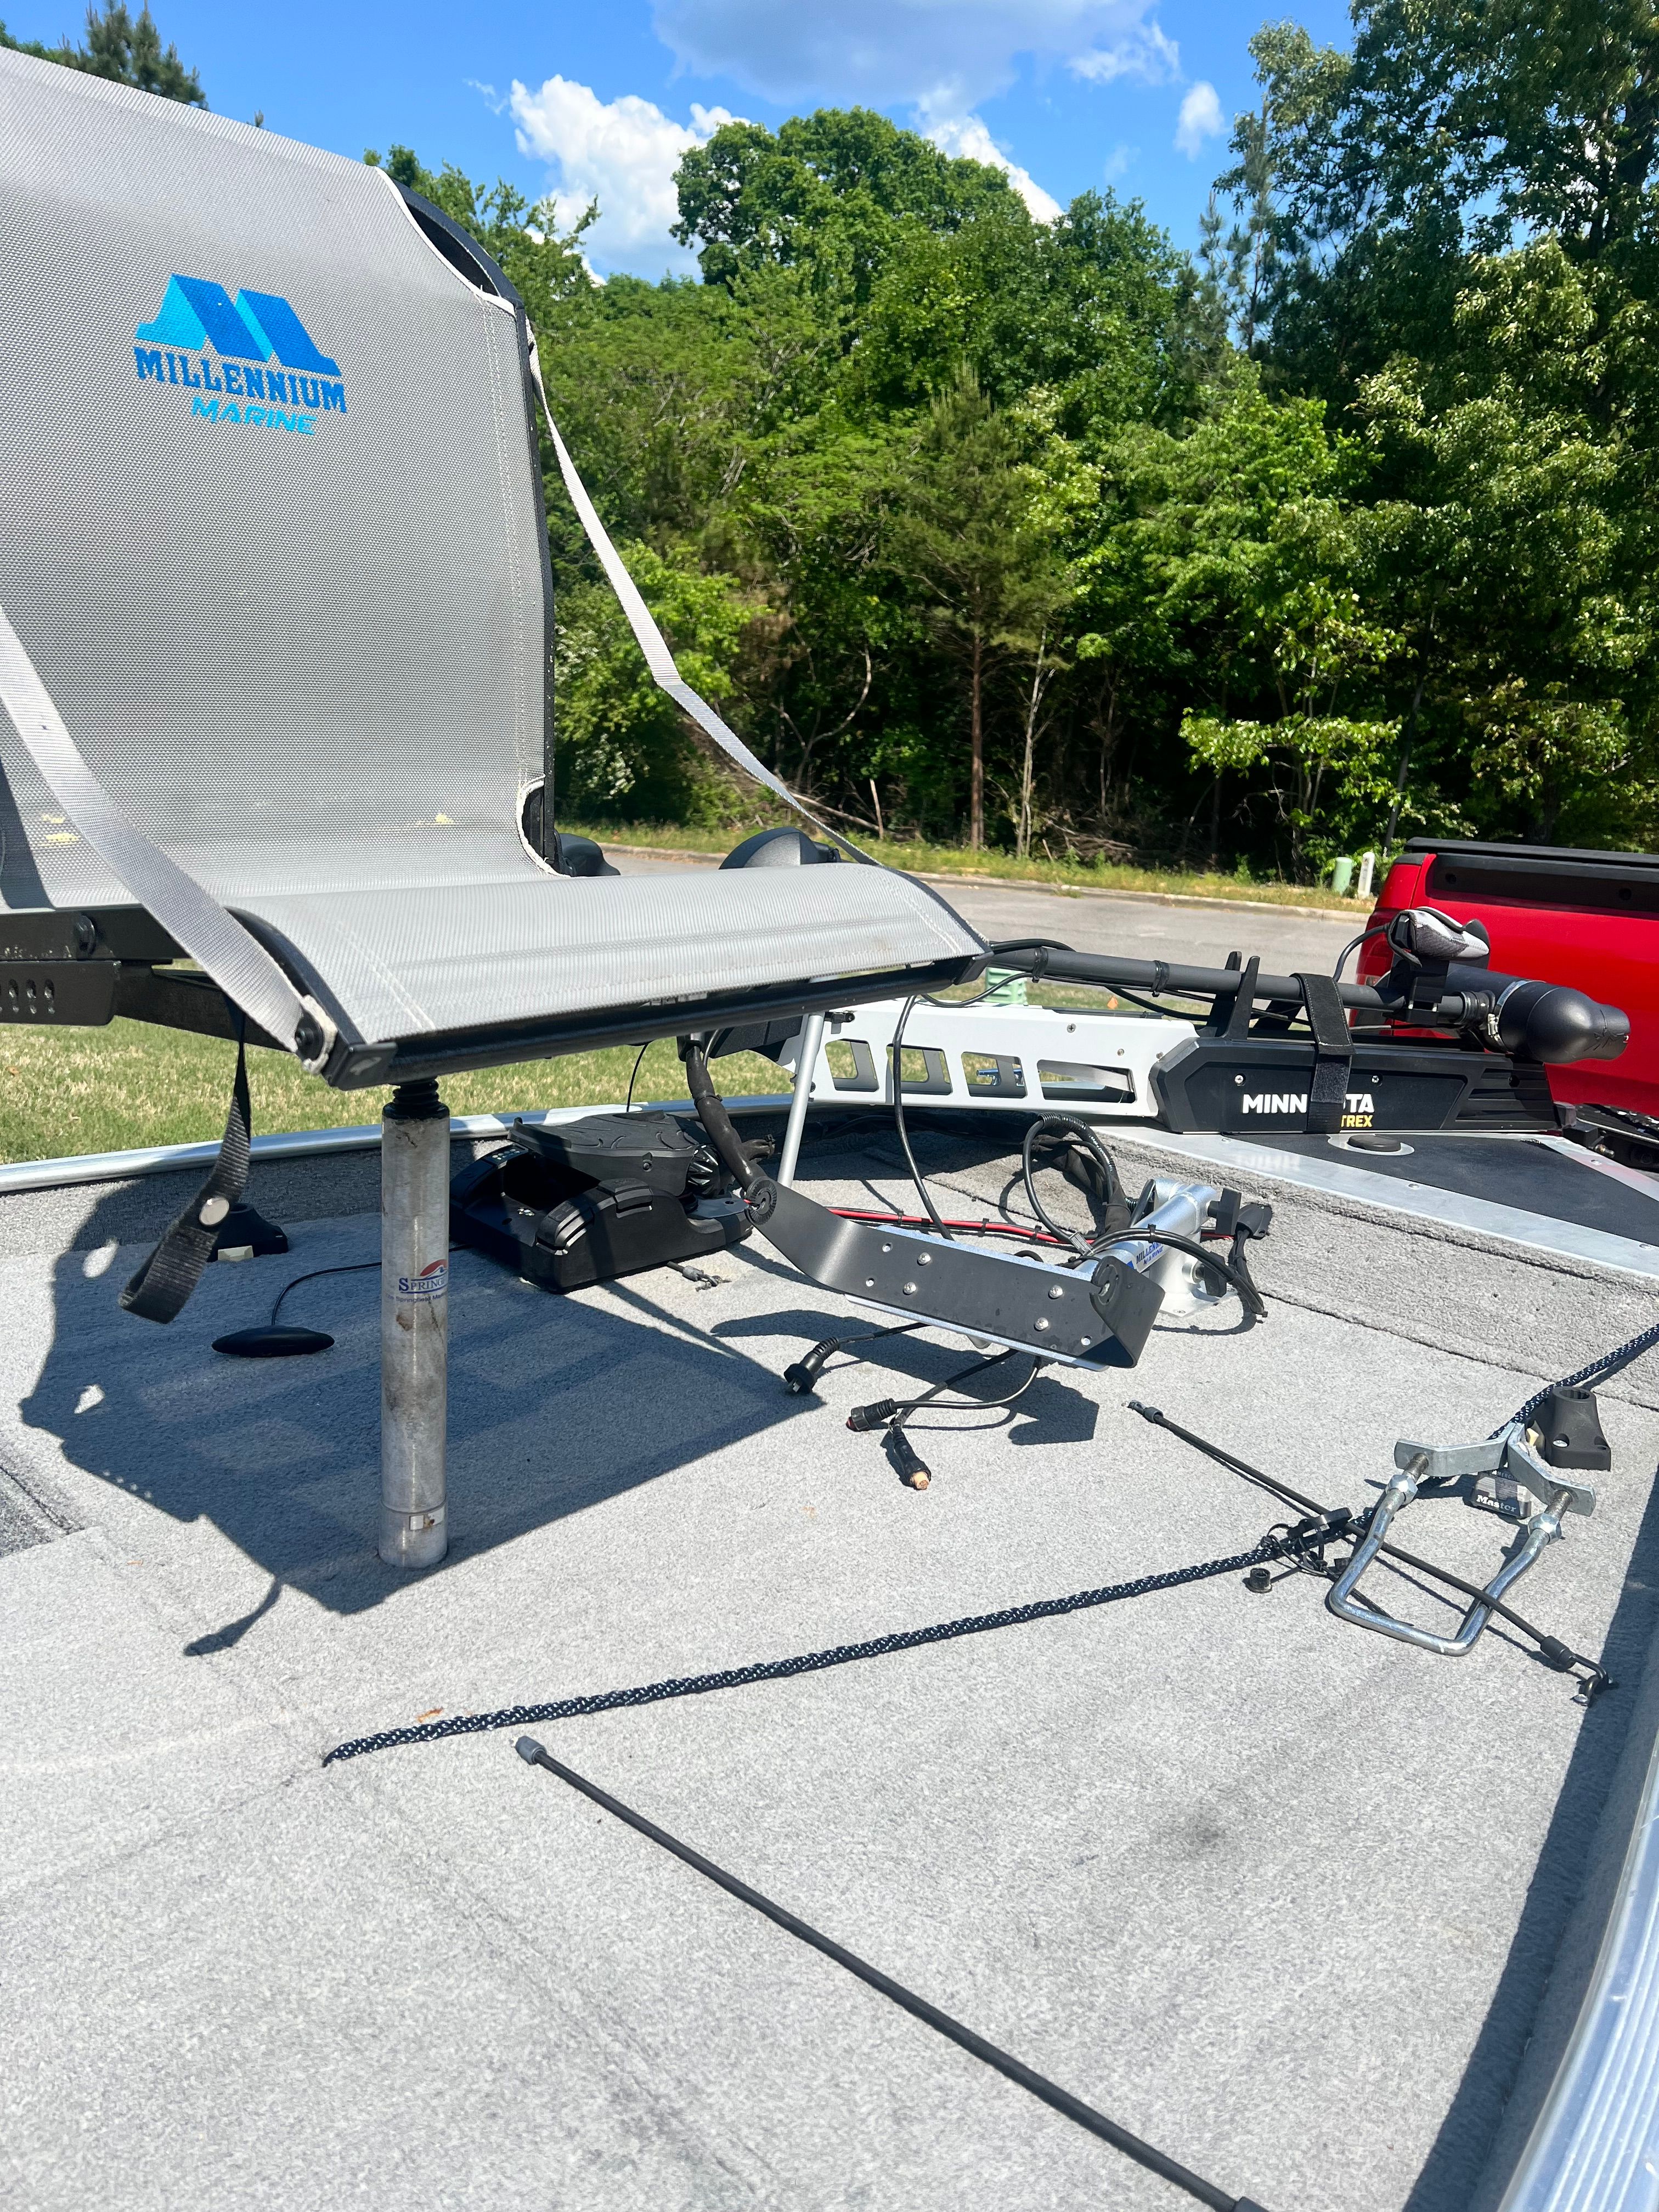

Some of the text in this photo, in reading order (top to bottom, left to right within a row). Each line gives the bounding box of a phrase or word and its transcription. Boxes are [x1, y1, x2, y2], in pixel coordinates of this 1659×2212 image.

[133, 347, 347, 413] MILLENNIUM
[191, 396, 318, 435] MARINE
[1242, 1093, 1375, 1114] MINN TA
[1341, 1115, 1373, 1127] TREX
[1143, 1246, 1164, 1265] MARINE
[399, 1278, 444, 1291] SPRING
[1476, 1494, 1517, 1512] Master
